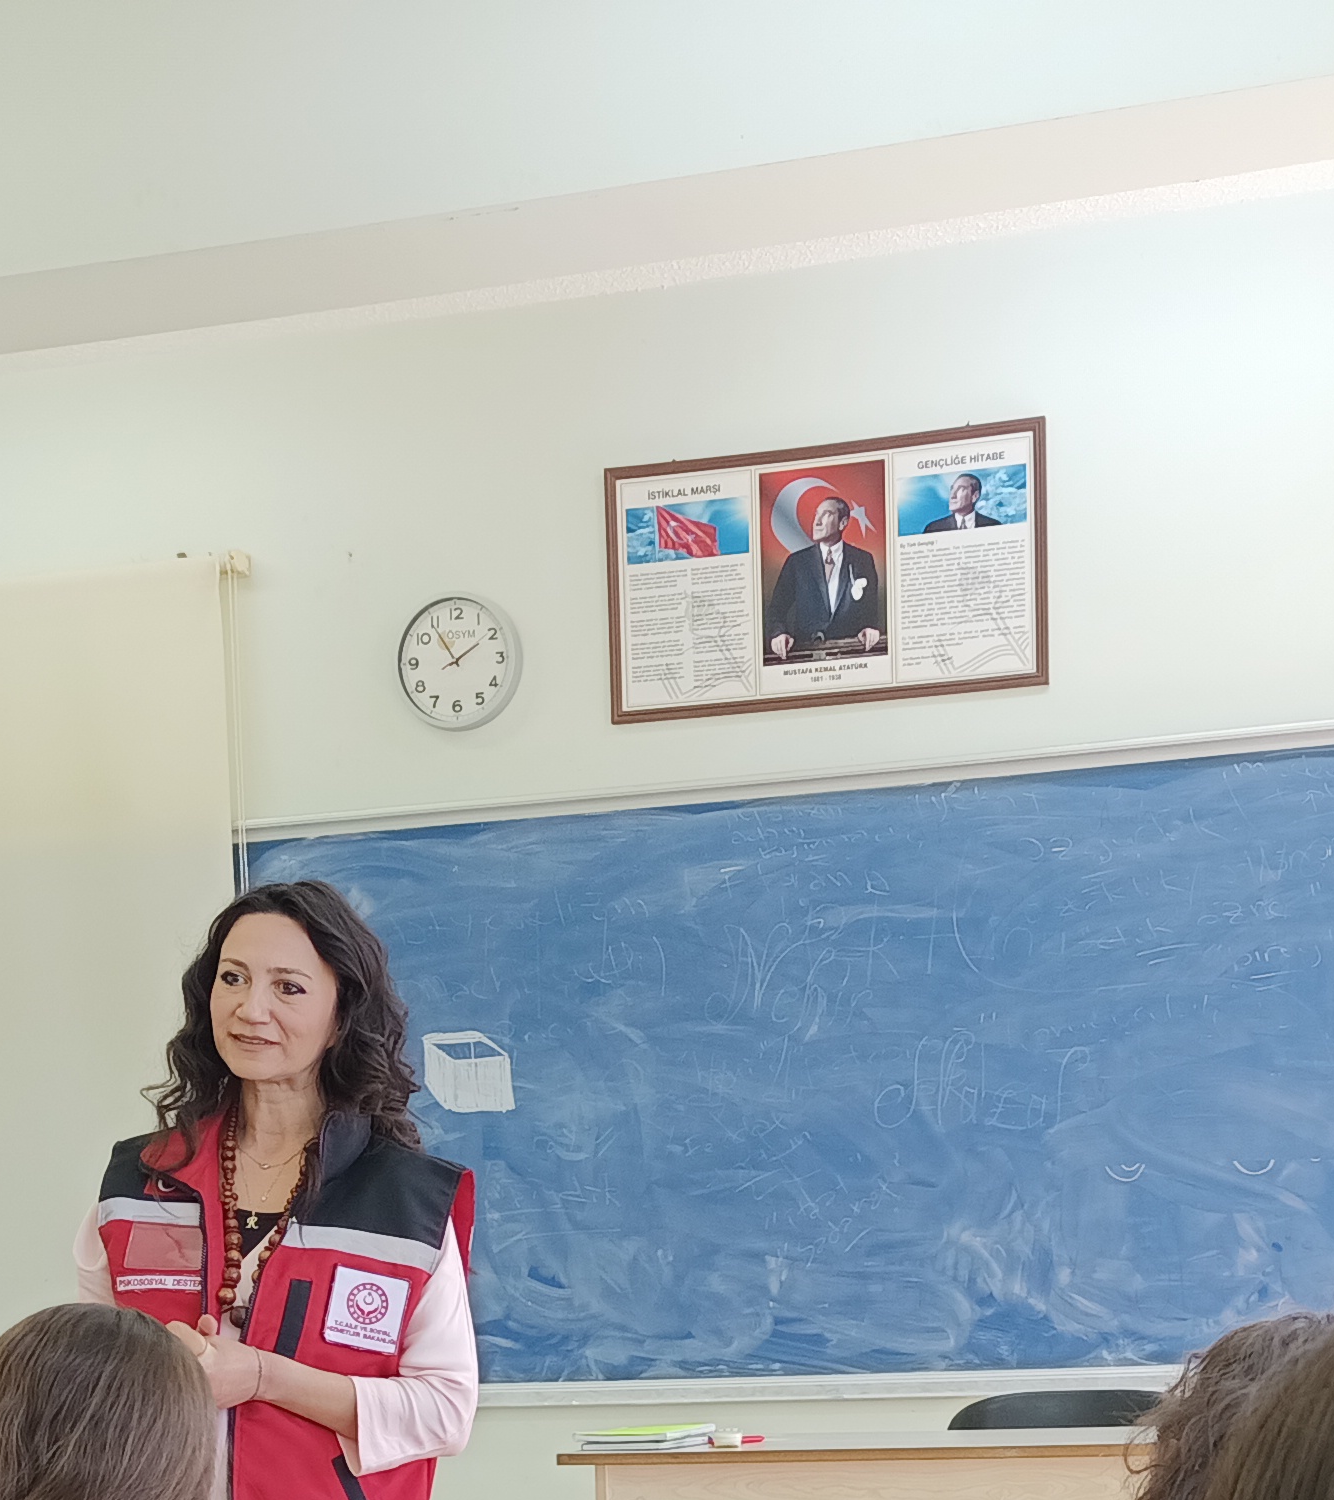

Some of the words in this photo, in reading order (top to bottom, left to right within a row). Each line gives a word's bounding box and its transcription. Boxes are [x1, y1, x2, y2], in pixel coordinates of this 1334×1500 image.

[917, 454, 967, 469] GENÇLİĞE
[969, 451, 1005, 463] HİTABE
[647, 488, 688, 500] İSTİKLAL
[690, 484, 721, 496] MARŞI
[449, 607, 464, 621] 12
[476, 612, 481, 626] 1
[430, 615, 440, 629] 11
[416, 632, 432, 646] 10
[446, 629, 476, 639] ÖSYM
[487, 627, 498, 640] 2
[408, 657, 419, 670] 9
[495, 651, 505, 664] 3
[783, 667, 813, 676] MUSTAFA
[814, 665, 837, 673] KEMAL
[838, 662, 868, 671] ATATÜRK
[414, 680, 426, 693] 8
[488, 675, 499, 688] 4
[429, 695, 440, 708] 7
[451, 699, 463, 713] 6
[475, 692, 485, 706] 5
